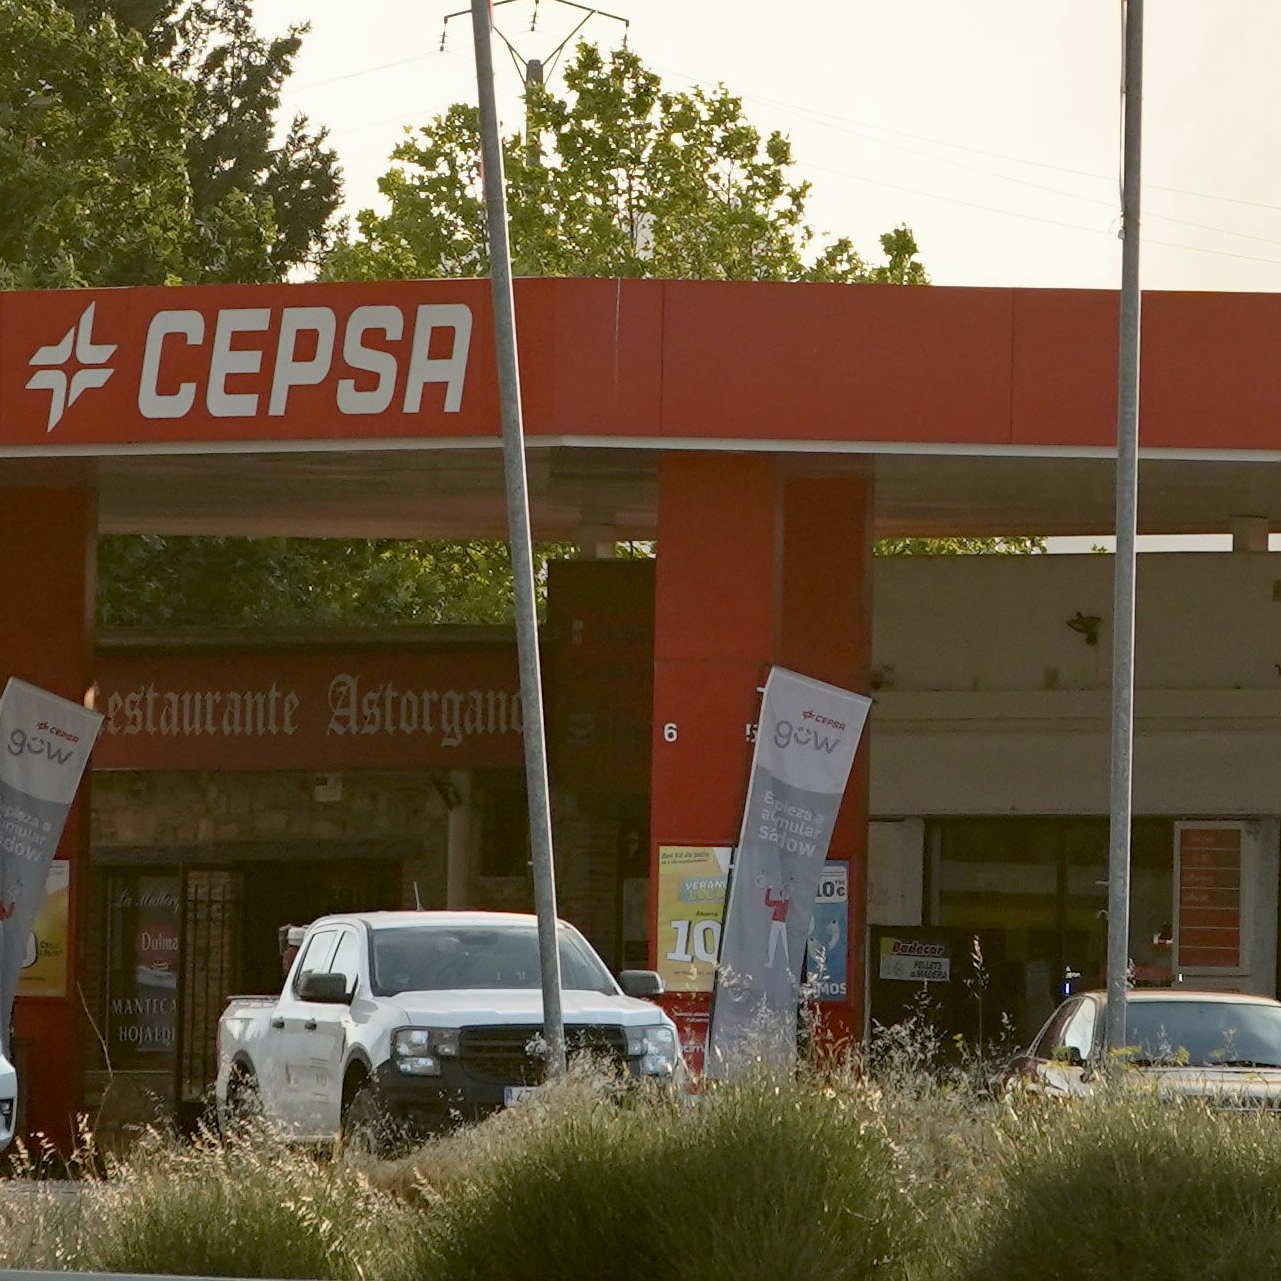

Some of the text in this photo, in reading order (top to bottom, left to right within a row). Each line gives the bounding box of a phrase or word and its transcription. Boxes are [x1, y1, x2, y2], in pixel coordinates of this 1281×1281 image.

[137, 303, 473, 419] CEPSA
[664, 722, 678, 742] 6
[685, 880, 727, 890] VERAN
[667, 920, 722, 963] 10
